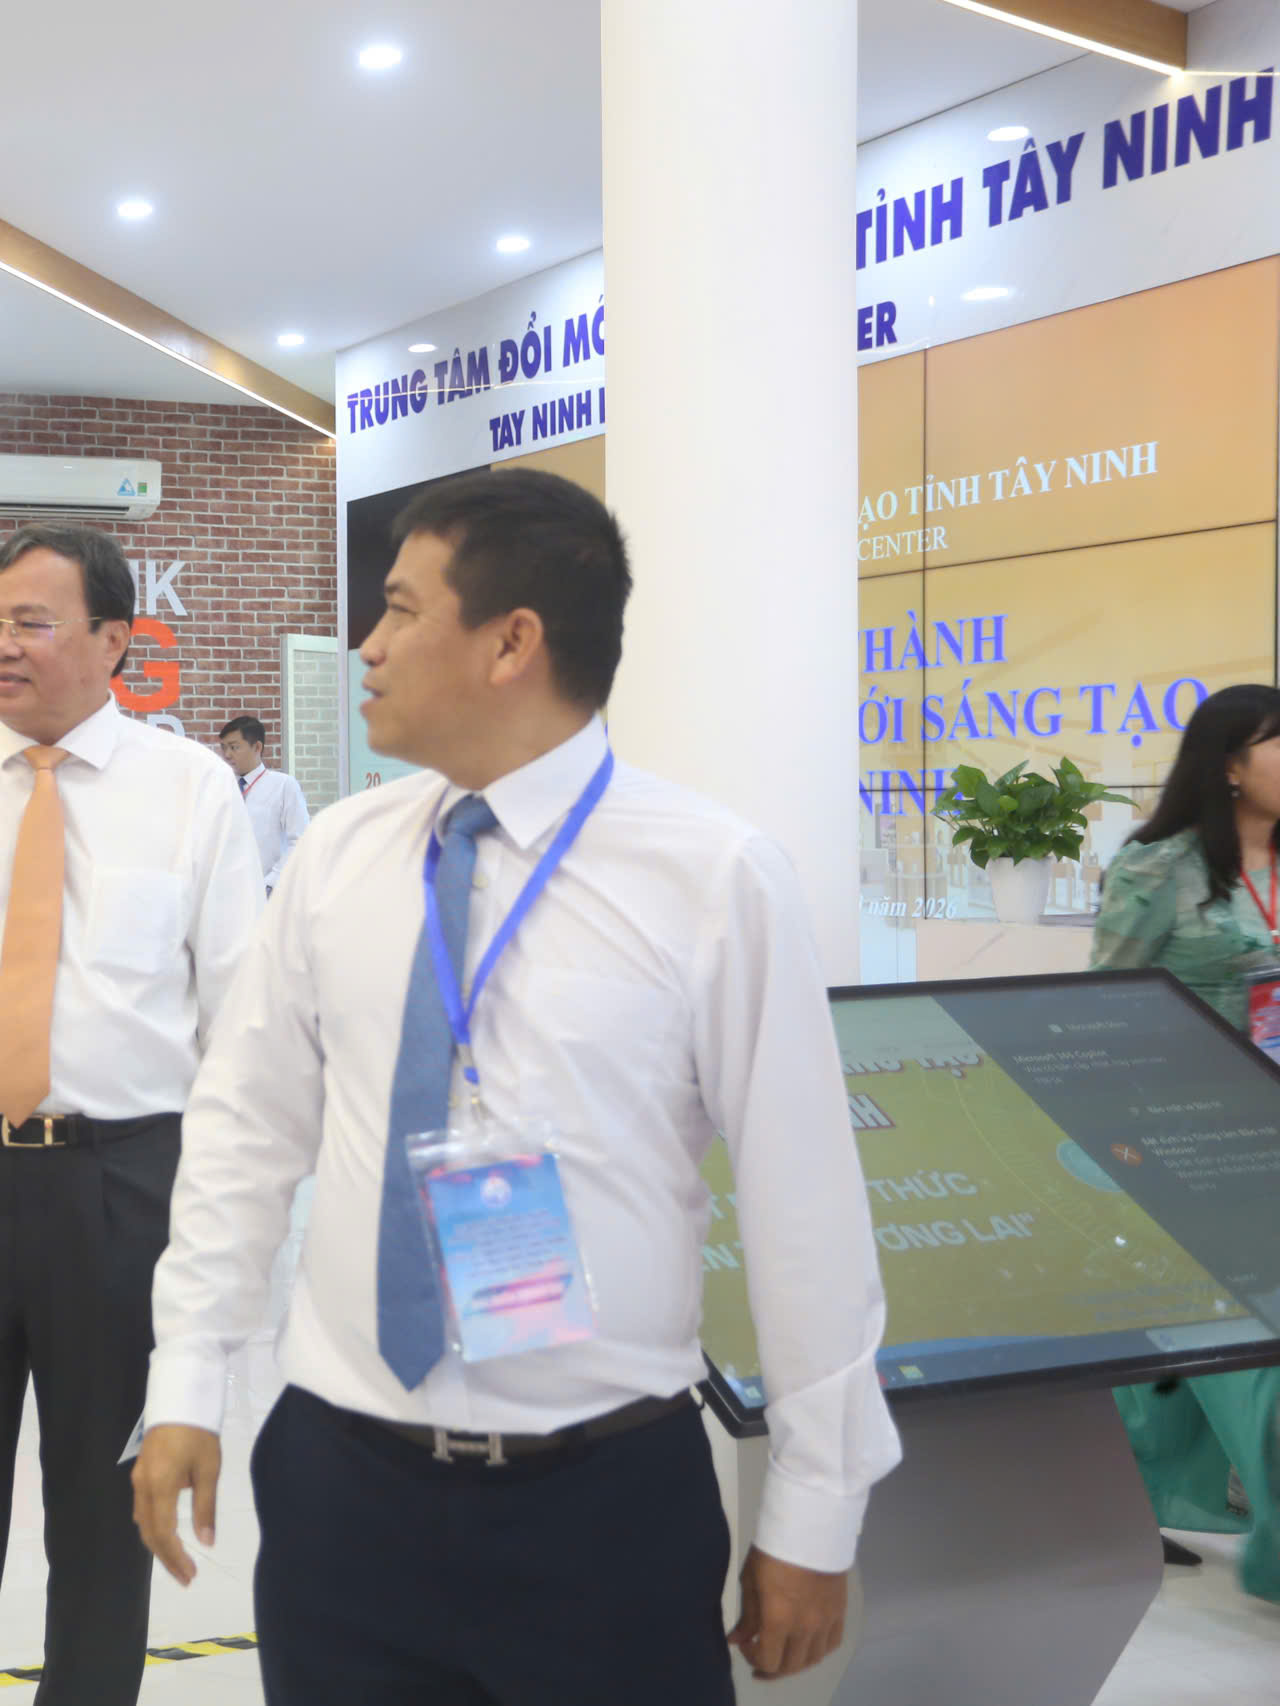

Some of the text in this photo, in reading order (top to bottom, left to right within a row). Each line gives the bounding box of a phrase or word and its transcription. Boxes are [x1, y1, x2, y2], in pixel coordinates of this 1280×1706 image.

[346, 369, 428, 434] TRUNG
[434, 347, 491, 406] TÂM
[498, 311, 552, 384] ĐỔI
[856, 177, 964, 271] TỈNH
[982, 131, 1085, 228] TÂY
[1103, 66, 1275, 190] NINH
[857, 300, 897, 352] ER
[489, 410, 525, 452] TAY
[532, 389, 592, 441] NINH
[857, 441, 1159, 531] ẠO TỈNH TÂY NINH
[857, 525, 949, 561] CENTER
[858, 610, 1008, 673] HÀNH
[858, 677, 1210, 748] ỚI SÁNG TẠO
[875, 1220, 966, 1251] ƠNG
